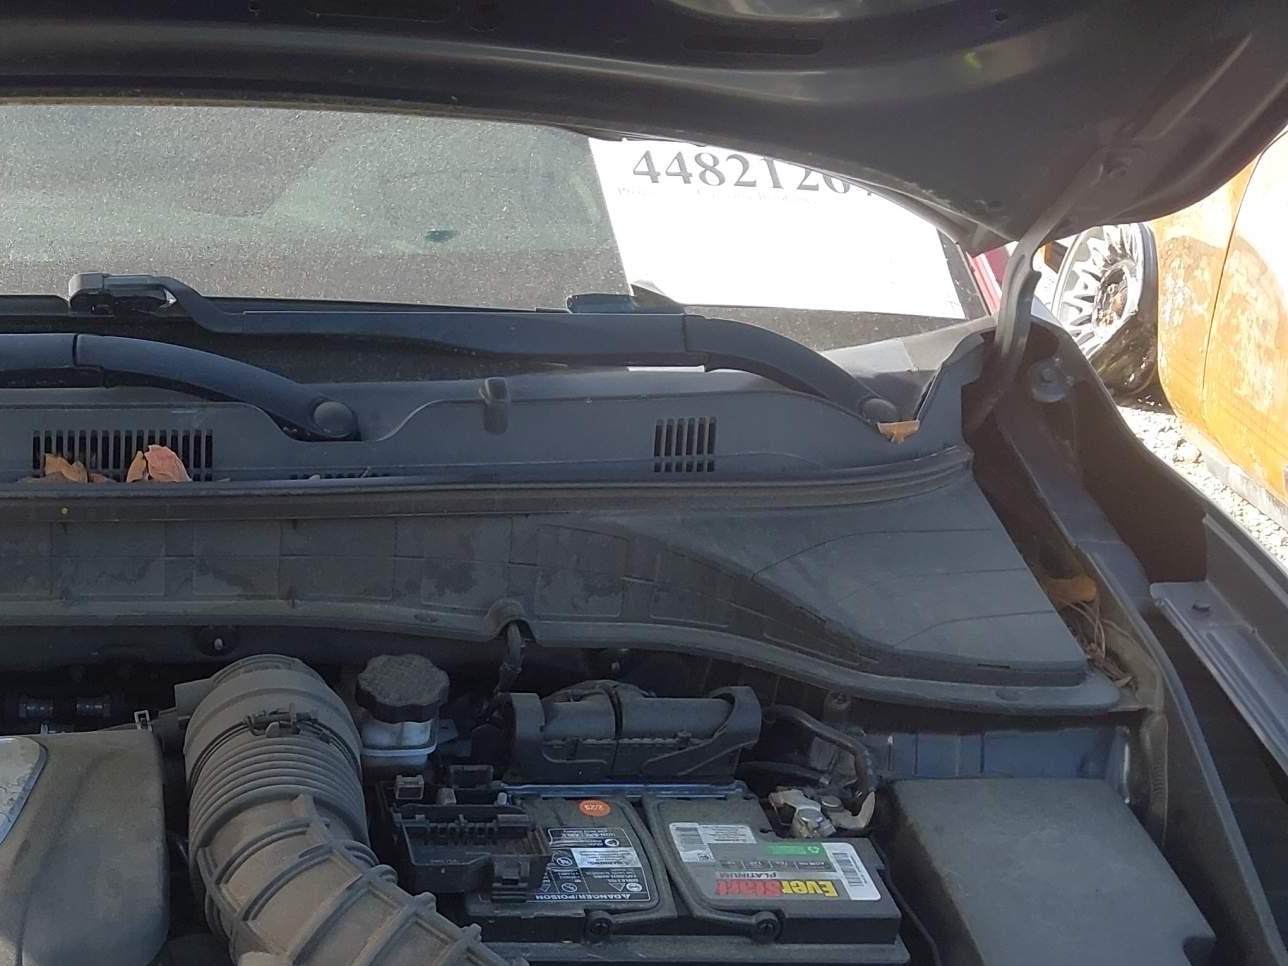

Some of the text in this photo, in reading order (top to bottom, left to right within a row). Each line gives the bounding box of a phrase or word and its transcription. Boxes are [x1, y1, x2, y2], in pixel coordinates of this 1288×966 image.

[632, 149, 873, 196] 4482126
[718, 871, 778, 879] PLATINUM
[715, 879, 839, 898] EverStart
